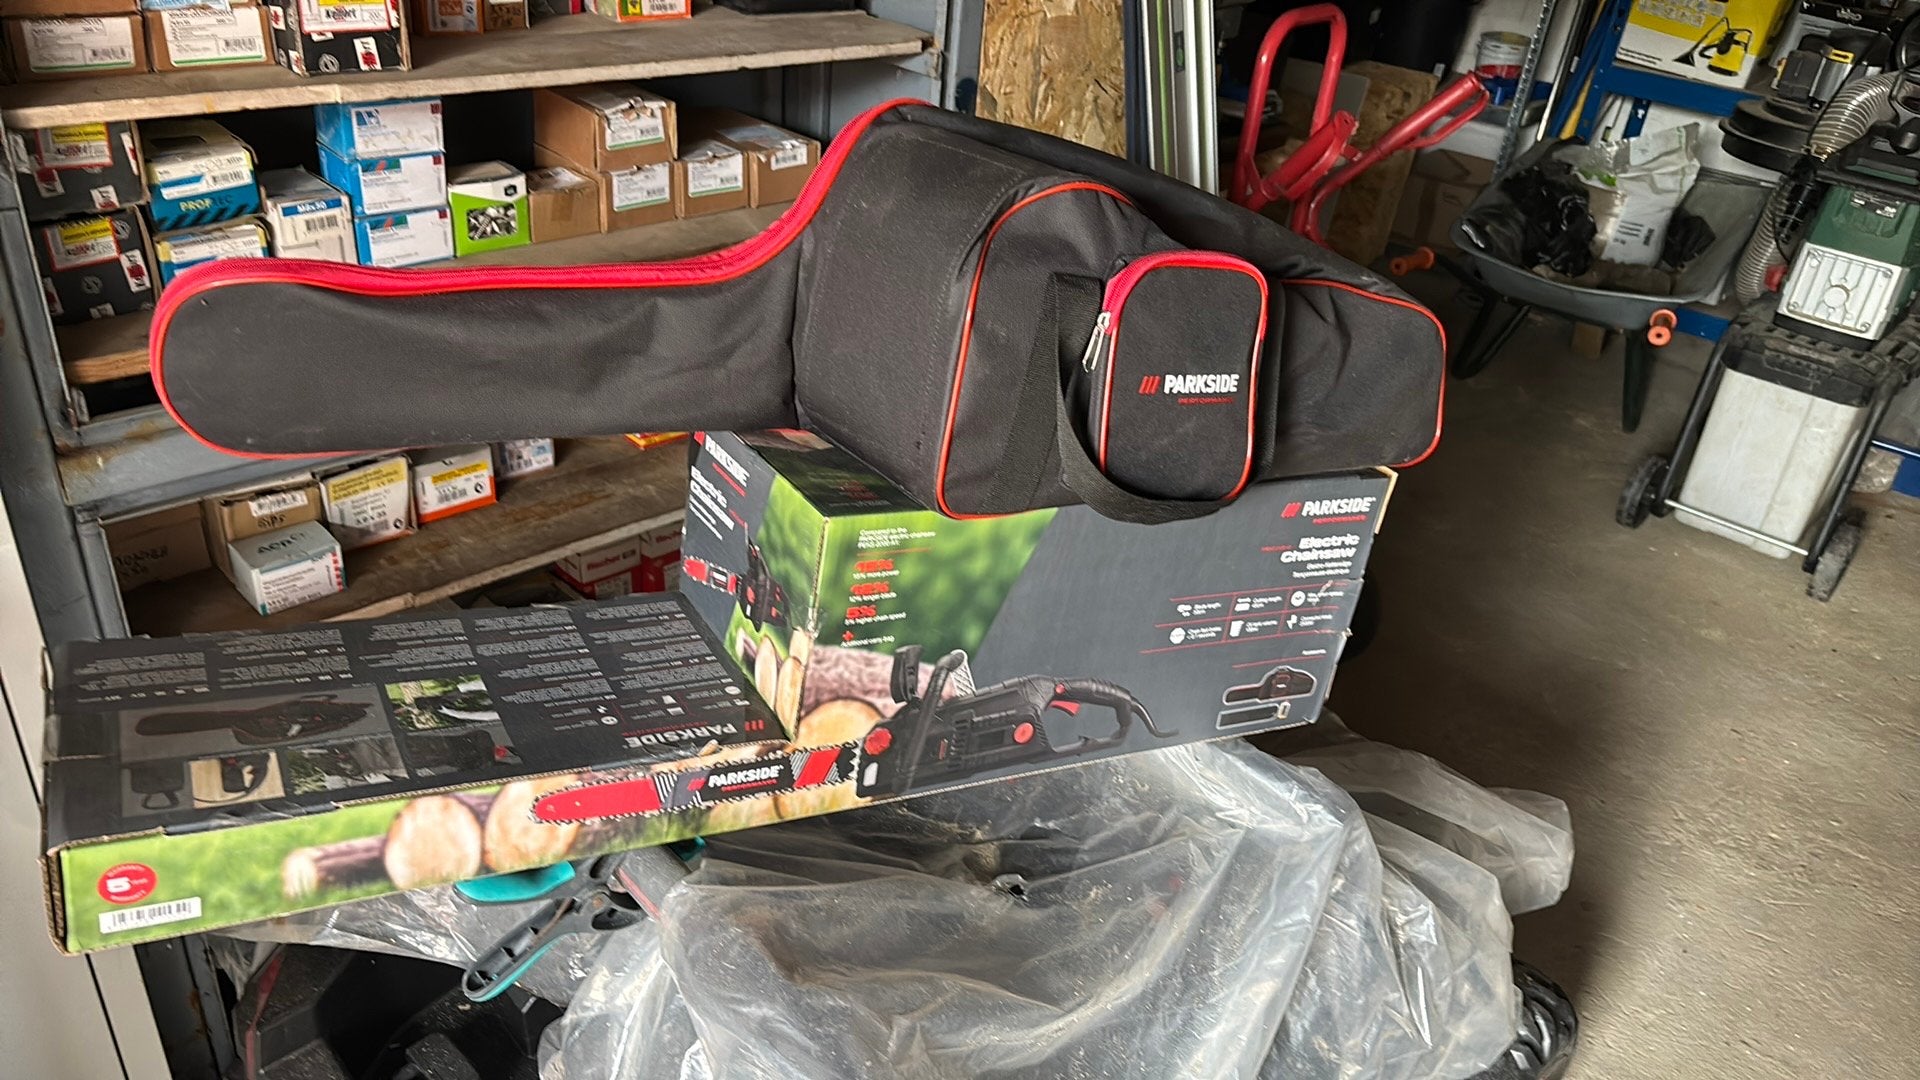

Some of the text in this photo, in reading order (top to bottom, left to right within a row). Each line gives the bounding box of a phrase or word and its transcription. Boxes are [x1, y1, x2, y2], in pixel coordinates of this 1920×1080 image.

[1164, 374, 1240, 394] PARKSIDE
[1302, 497, 1371, 516] PARKSIDE
[1299, 533, 1360, 549] Electric
[1280, 547, 1357, 564] Chainsaw
[624, 722, 738, 748] PARKSIDE
[708, 766, 780, 788] PARKSIDE
